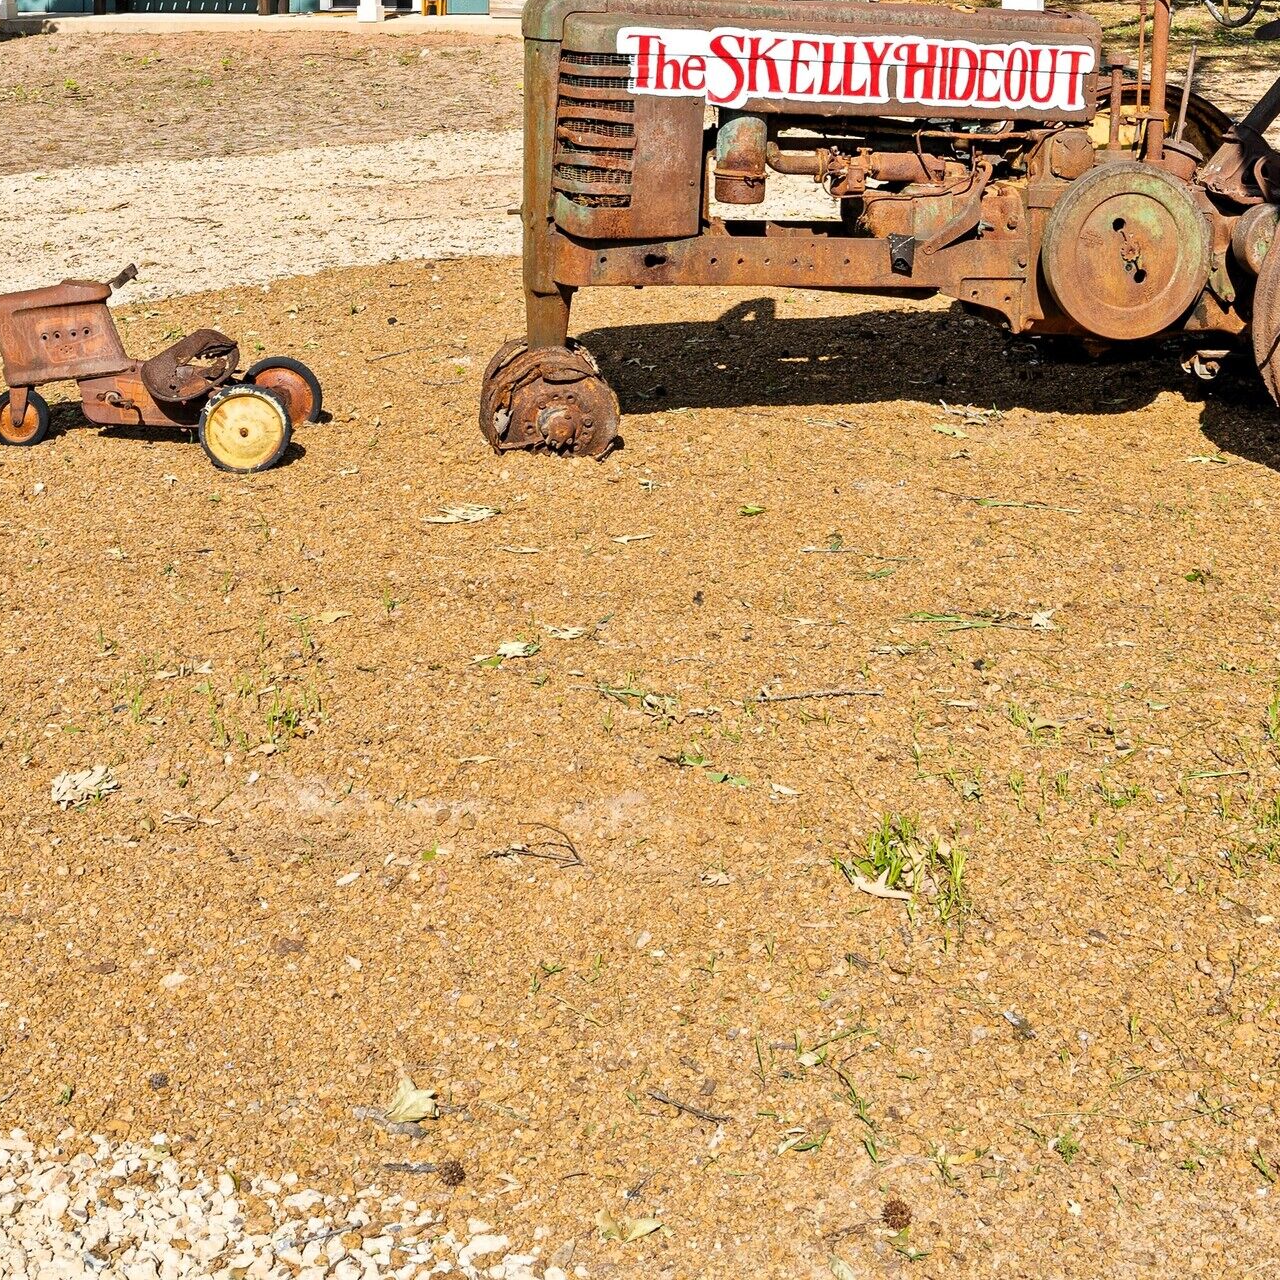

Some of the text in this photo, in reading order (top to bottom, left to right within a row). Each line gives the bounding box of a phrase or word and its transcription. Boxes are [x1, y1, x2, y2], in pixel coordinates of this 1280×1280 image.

[627, 34, 1091, 105] The SKELLY HIDEOUT
